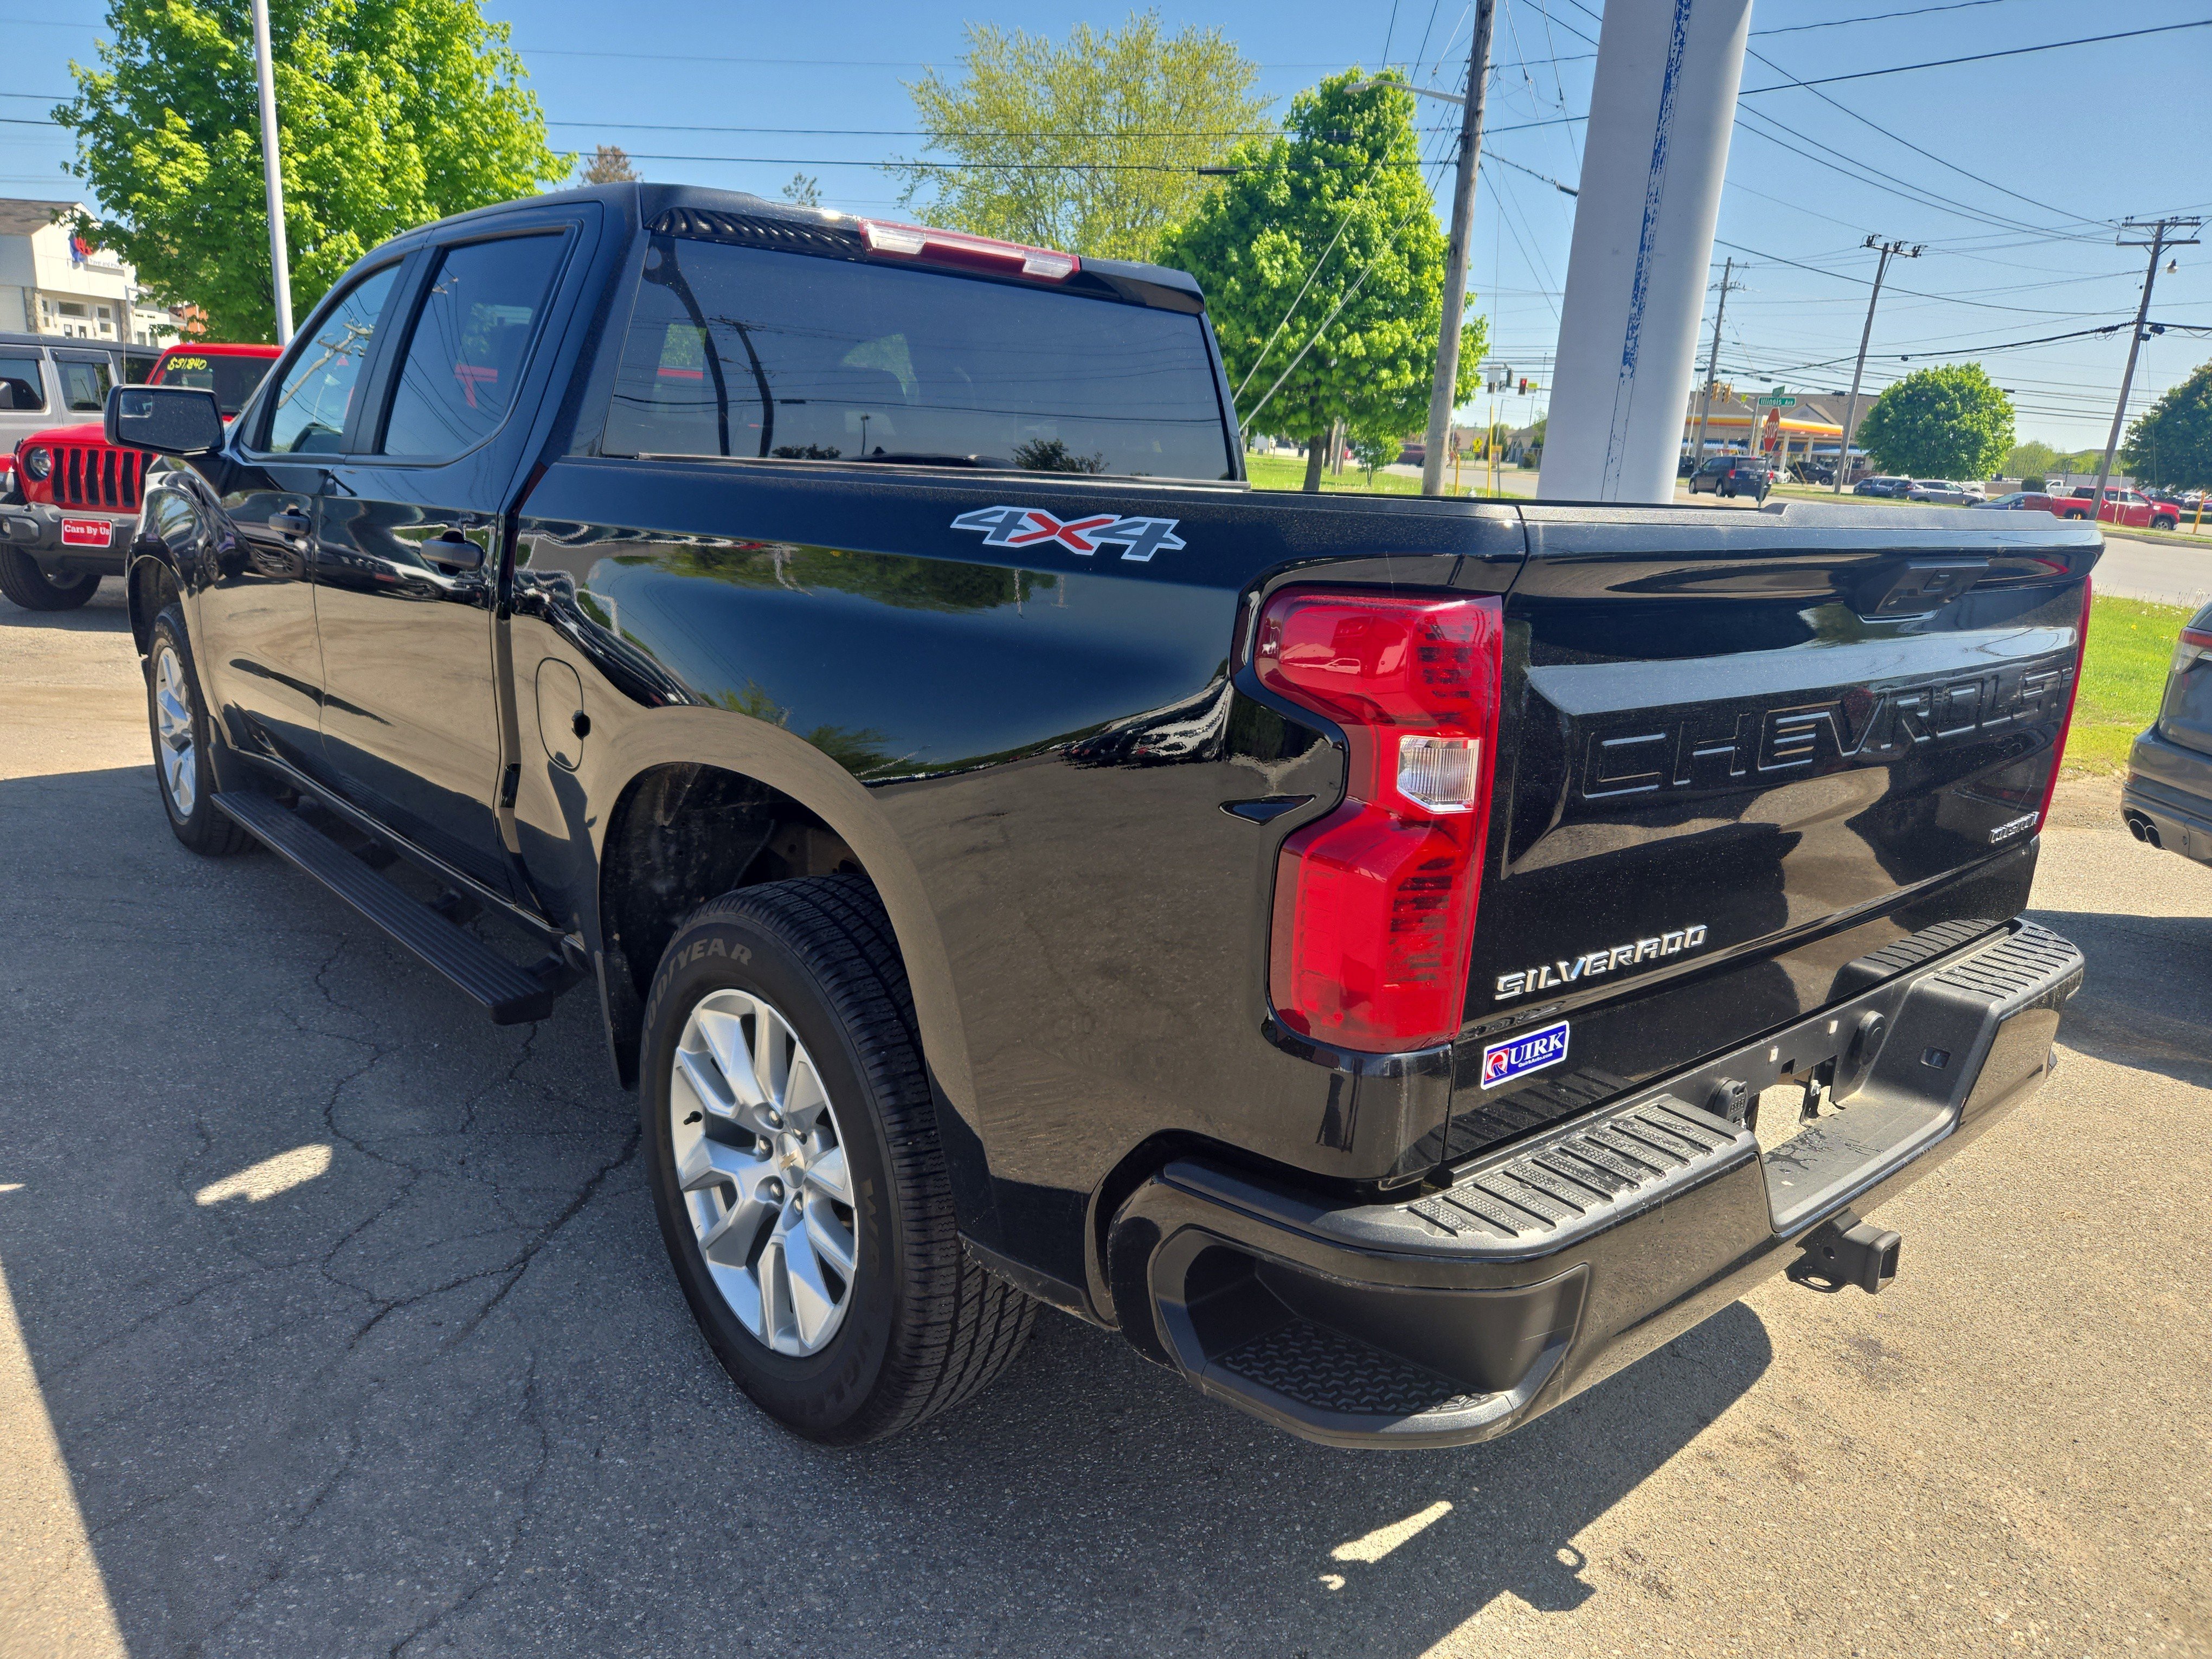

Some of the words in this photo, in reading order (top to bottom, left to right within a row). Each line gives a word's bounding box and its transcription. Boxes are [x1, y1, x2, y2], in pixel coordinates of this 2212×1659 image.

[1760, 397, 1782, 406] Illinois
[1765, 422, 1778, 438] STOP
[65, 524, 85, 533] Cars
[87, 525, 98, 536] By
[99, 526, 111, 535] Us
[1494, 924, 1708, 1000] SILVERADO
[1487, 1031, 1565, 1077] QUIRK
[1517, 1052, 1553, 1068] QuirkAuto.com
